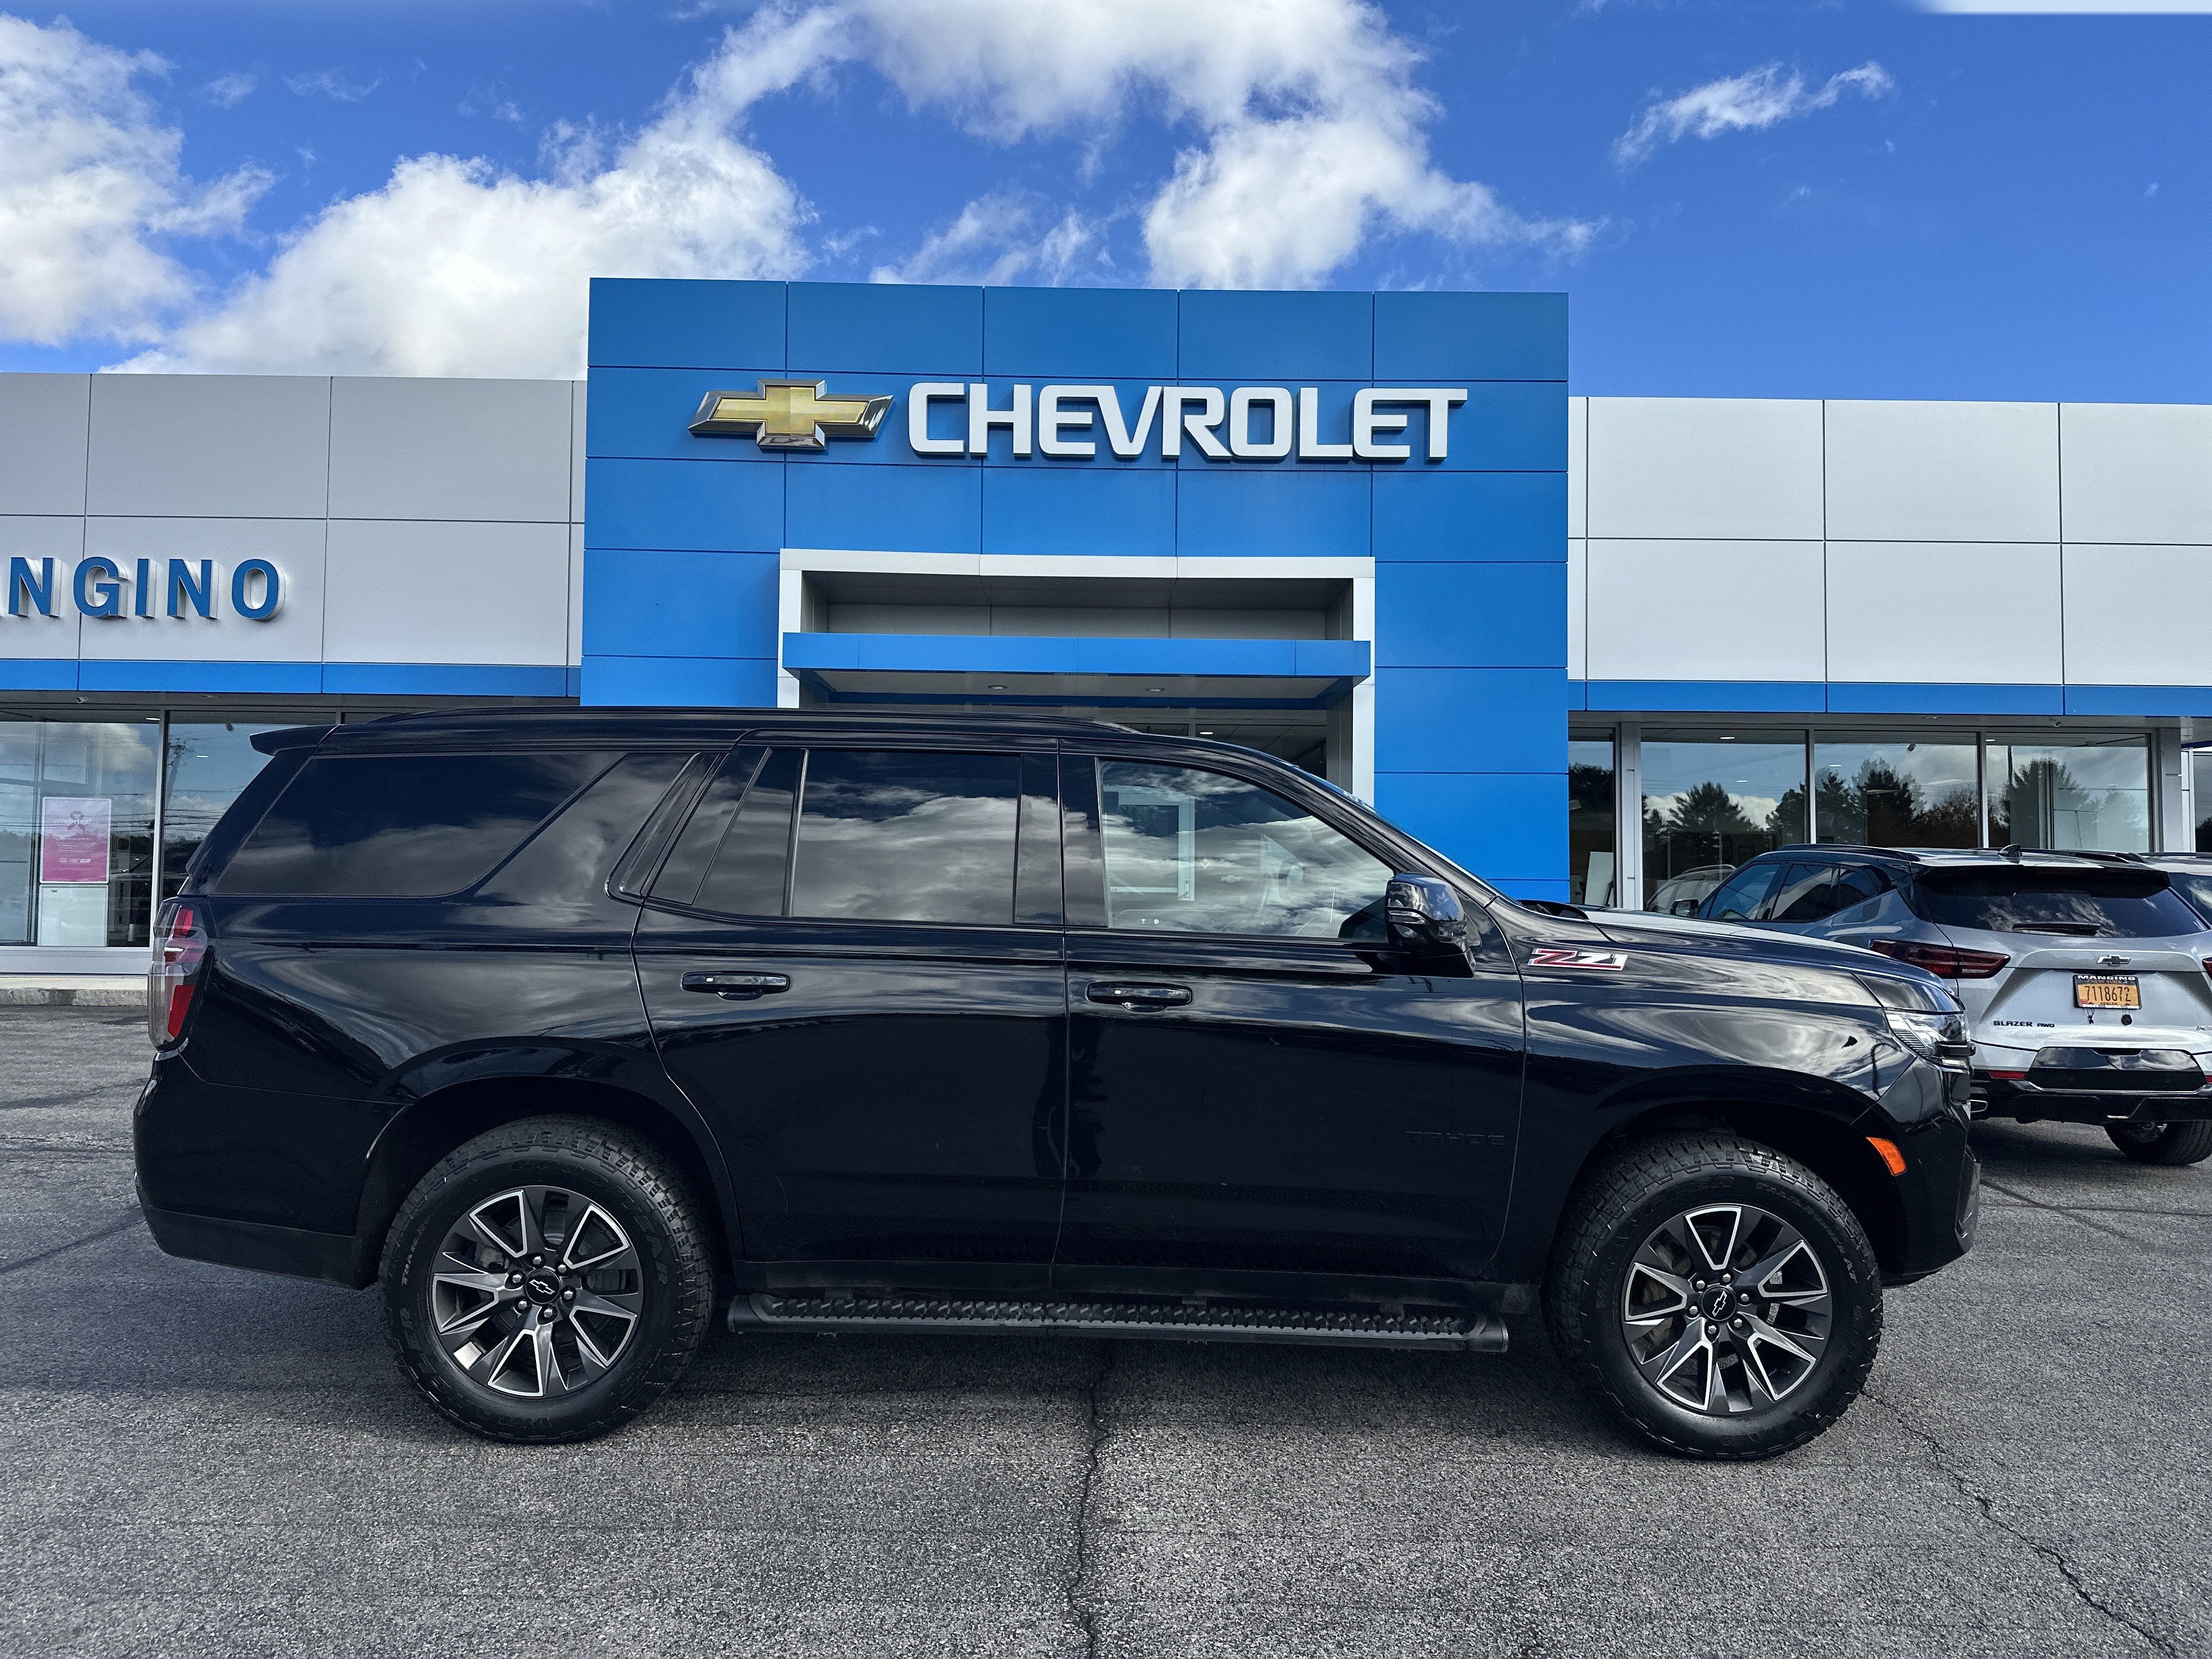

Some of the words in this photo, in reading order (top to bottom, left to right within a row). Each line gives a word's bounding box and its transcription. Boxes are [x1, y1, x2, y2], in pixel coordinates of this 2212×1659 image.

[909, 382, 1469, 462] CHEVROLET
[2, 556, 284, 620] NGINO
[1527, 947, 1628, 972] Z71
[2085, 985, 2131, 1002] 7118672
[1404, 1131, 1505, 1146] TAHOE
[510, 1159, 668, 1284] GOODYEAR
